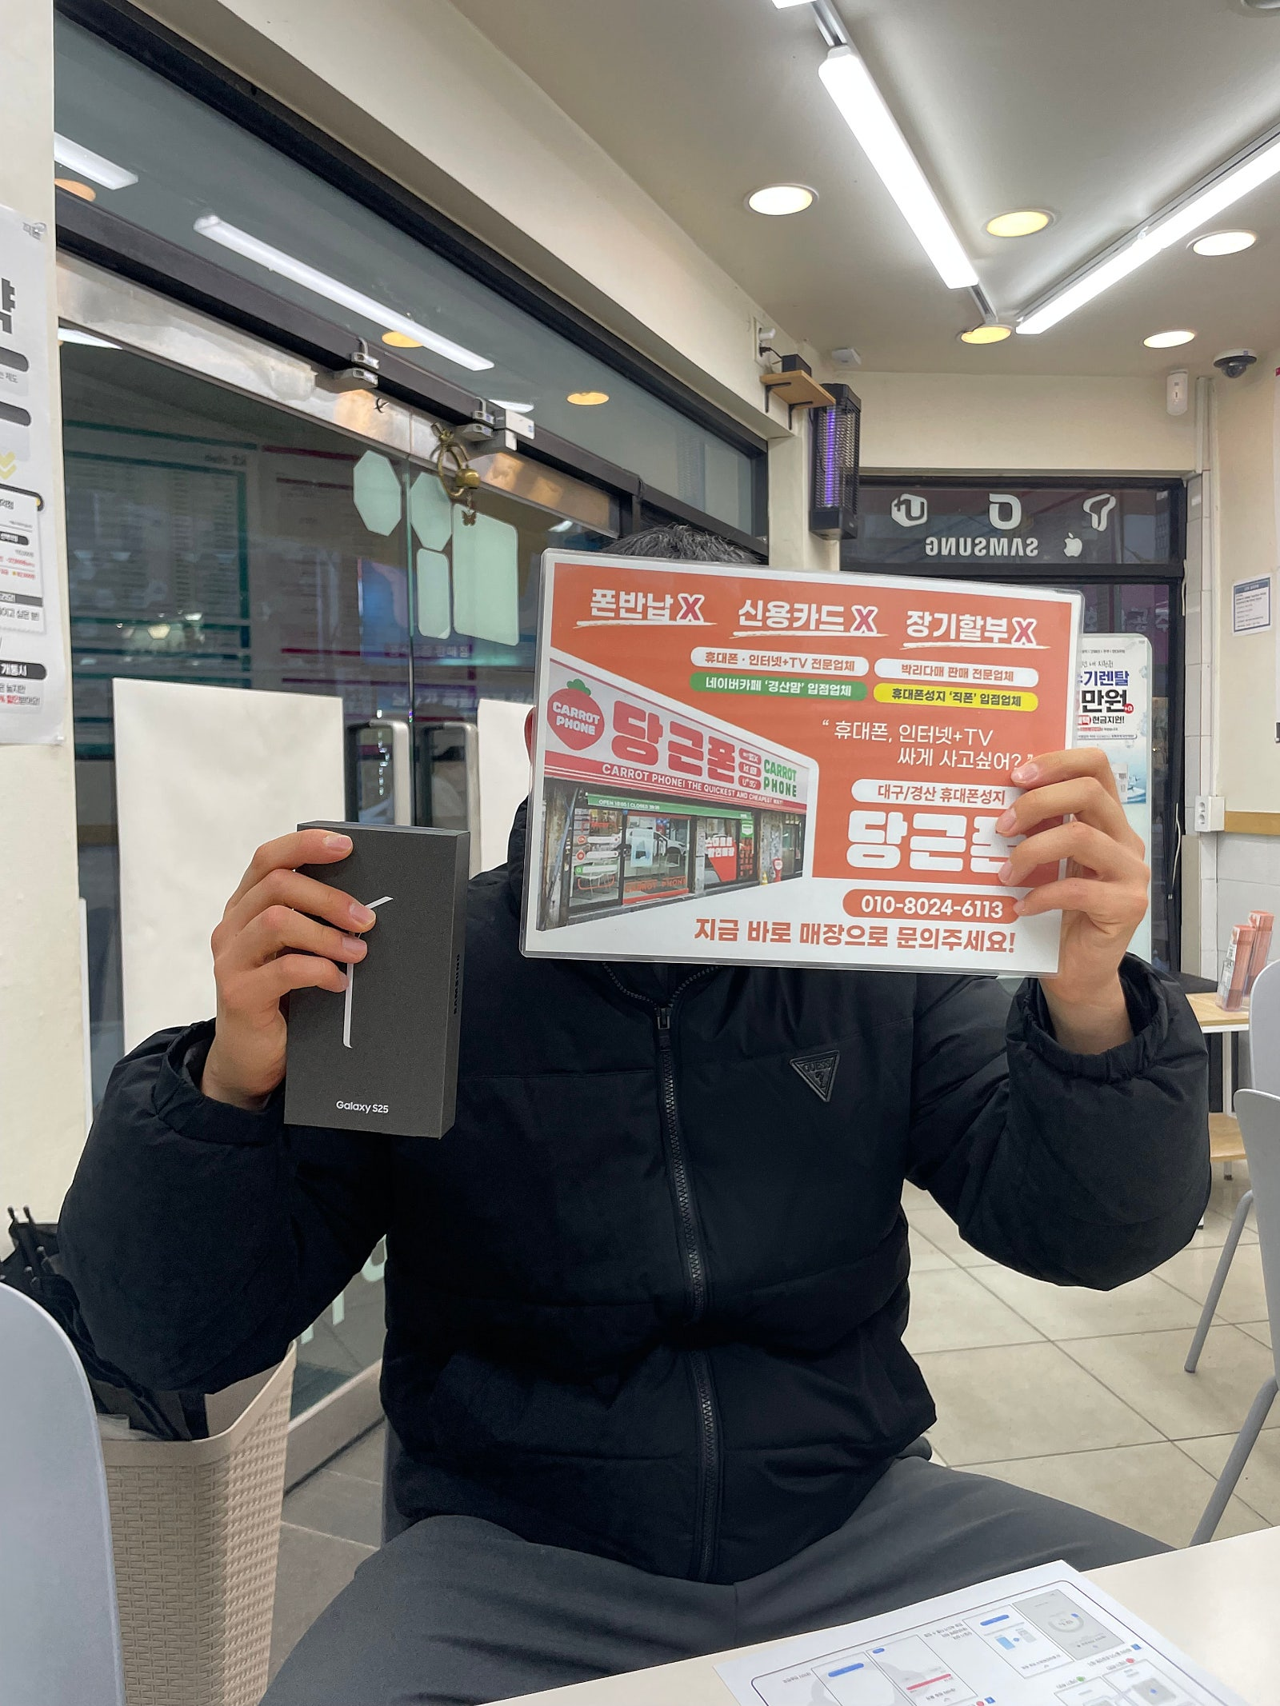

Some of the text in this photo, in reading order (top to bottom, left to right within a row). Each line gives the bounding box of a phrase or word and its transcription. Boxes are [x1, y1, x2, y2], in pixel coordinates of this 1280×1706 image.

[705, 652, 855, 672] 휴대폰 인터넷+TV 전문업체
[901, 664, 1014, 682] 박리다매 판매 전문업체
[705, 676, 762, 692] 네이버카페
[807, 682, 852, 697] 입점업체
[1079, 671, 1130, 686] 기렌탈
[892, 688, 946, 702] 휴대폰성지
[980, 693, 1022, 707] 입점업체
[1081, 689, 1127, 713] 만원
[552, 701, 600, 725] CARROT
[556, 716, 596, 736] PHONE
[834, 720, 994, 746] 휴대폰, 인터넷+TV
[611, 700, 736, 784] 당근폰
[897, 747, 933, 767] 싸게
[602, 763, 650, 782] CARROT
[688, 780, 702, 790] THE
[703, 784, 735, 797] QUICKEST
[763, 759, 797, 782] CARROT
[763, 776, 797, 798] PHONE
[877, 784, 1006, 806] 대구/경산 휴대폰성지
[861, 895, 1003, 919] 010-8024-6113
[694, 918, 1016, 953] 지금 바로 매장으로 문의주세요!
[336, 1100, 389, 1114] Galaxy S25
